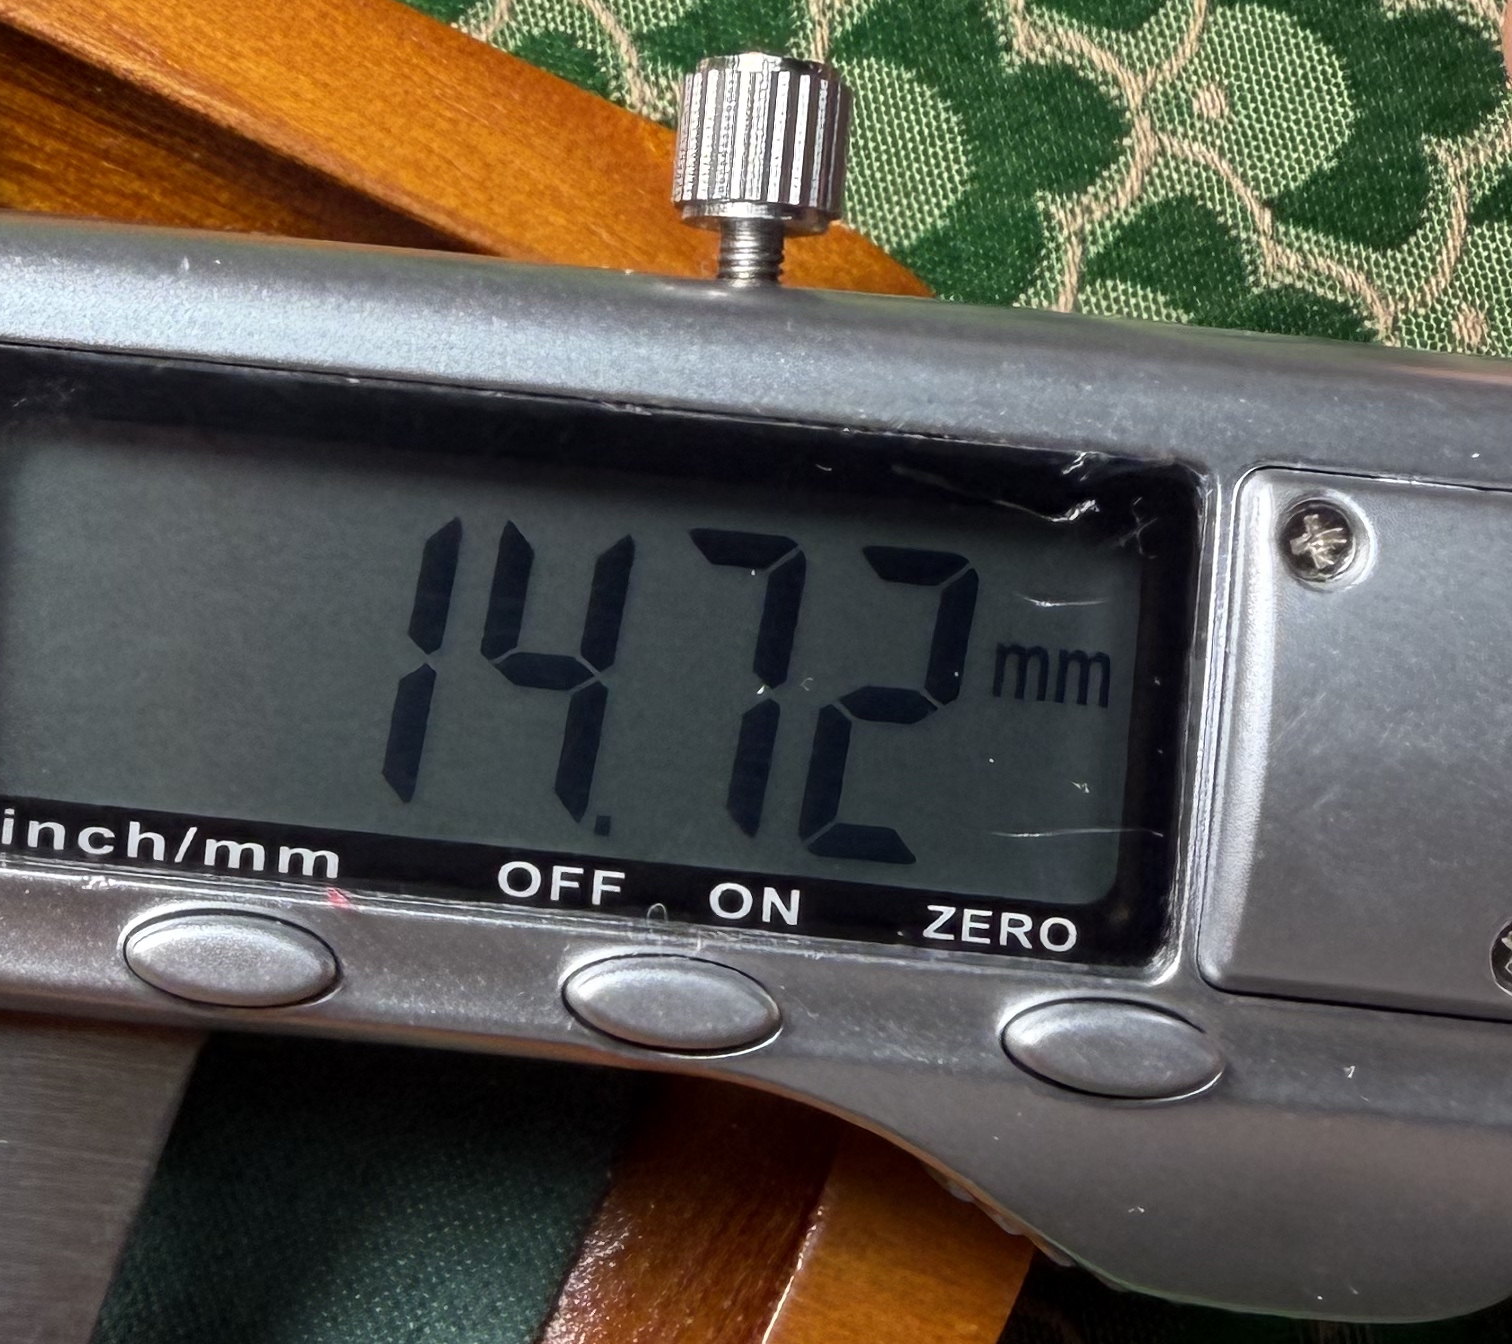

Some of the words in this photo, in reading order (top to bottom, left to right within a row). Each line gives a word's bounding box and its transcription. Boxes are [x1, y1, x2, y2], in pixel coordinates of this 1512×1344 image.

[993, 640, 1111, 708] mm
[2, 809, 339, 879] inch/mm
[498, 861, 625, 905] OFF
[709, 883, 800, 925] ON
[923, 905, 1077, 953] ZERO
